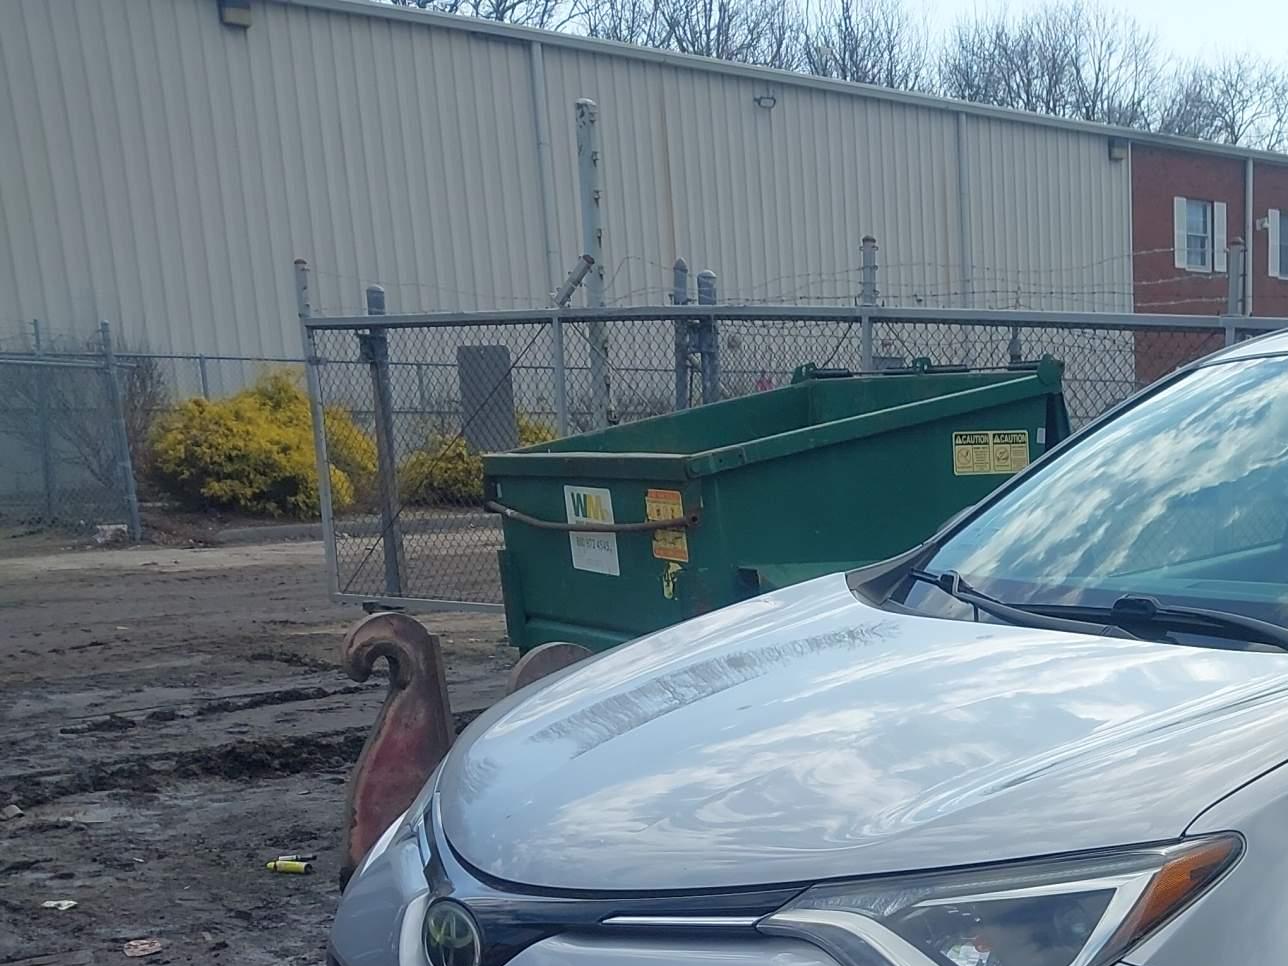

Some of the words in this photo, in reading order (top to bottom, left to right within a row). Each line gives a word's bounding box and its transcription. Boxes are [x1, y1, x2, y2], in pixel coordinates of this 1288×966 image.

[961, 434, 989, 444] CAUTION
[999, 433, 1026, 443] CAUTION
[570, 491, 605, 519] WM
